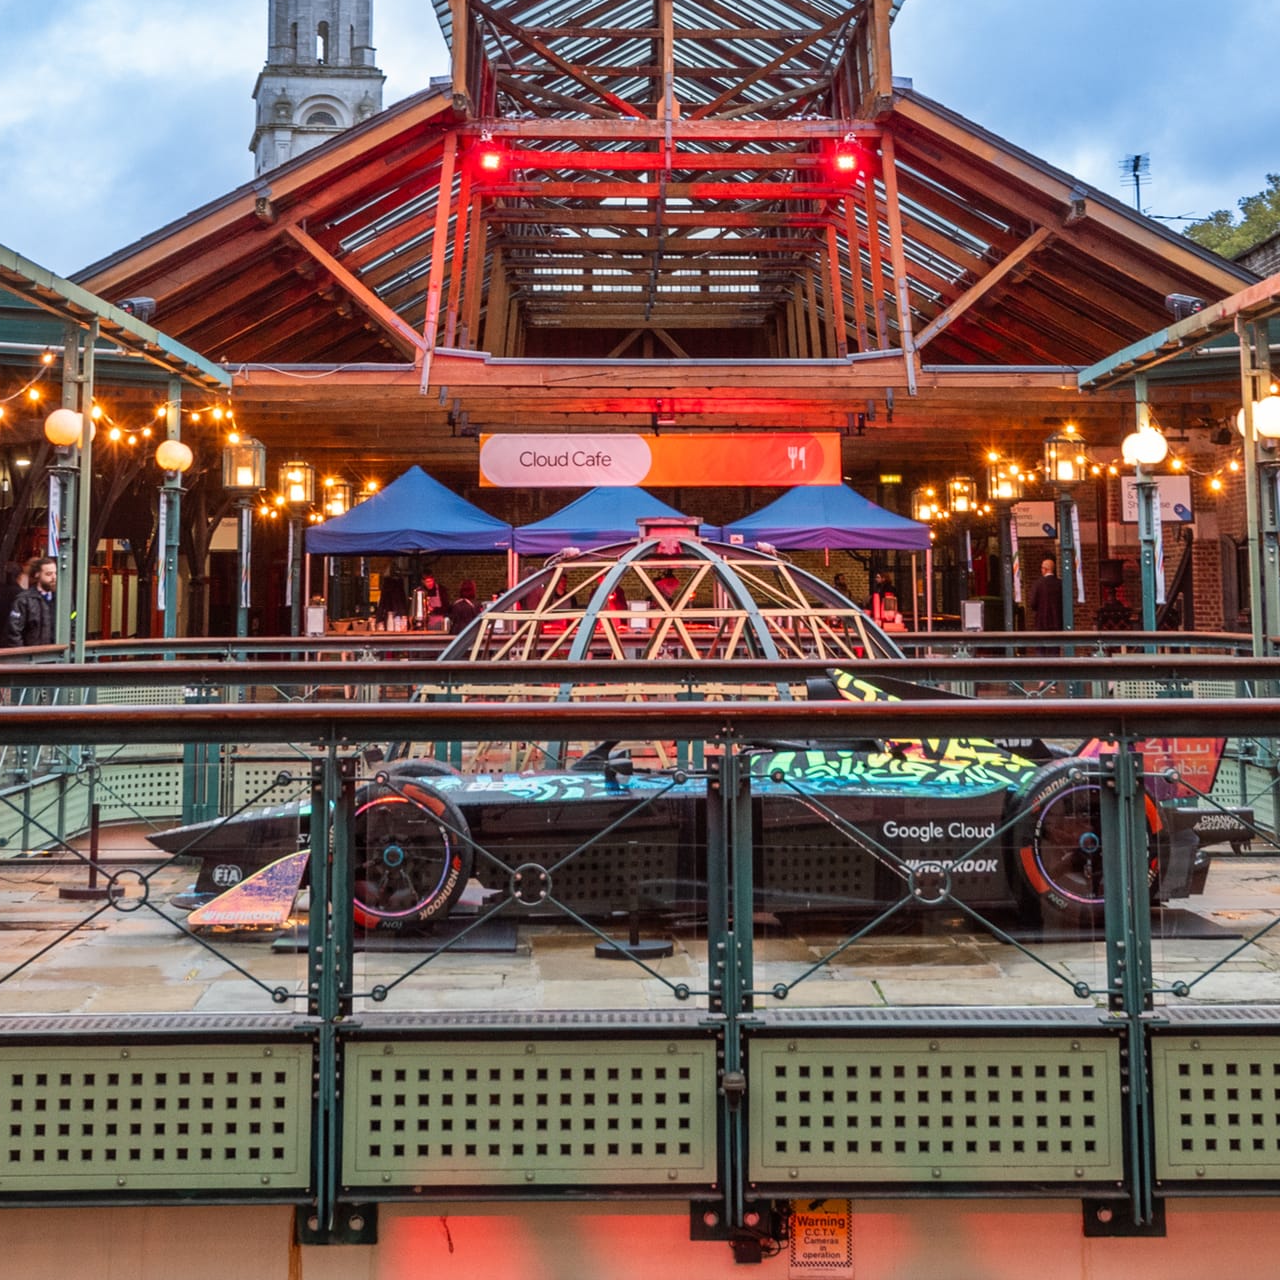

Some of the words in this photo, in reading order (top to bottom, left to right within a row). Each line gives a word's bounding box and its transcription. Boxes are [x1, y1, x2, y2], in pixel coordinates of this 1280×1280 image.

[520, 451, 568, 467] Cloud
[572, 451, 612, 467] Cafe
[883, 821, 943, 842] Google
[948, 822, 995, 839] Cloud
[214, 867, 240, 884] FIA
[797, 1216, 845, 1228] Warning
[804, 1237, 839, 1245] Cameras
[802, 1252, 841, 1260] operation
